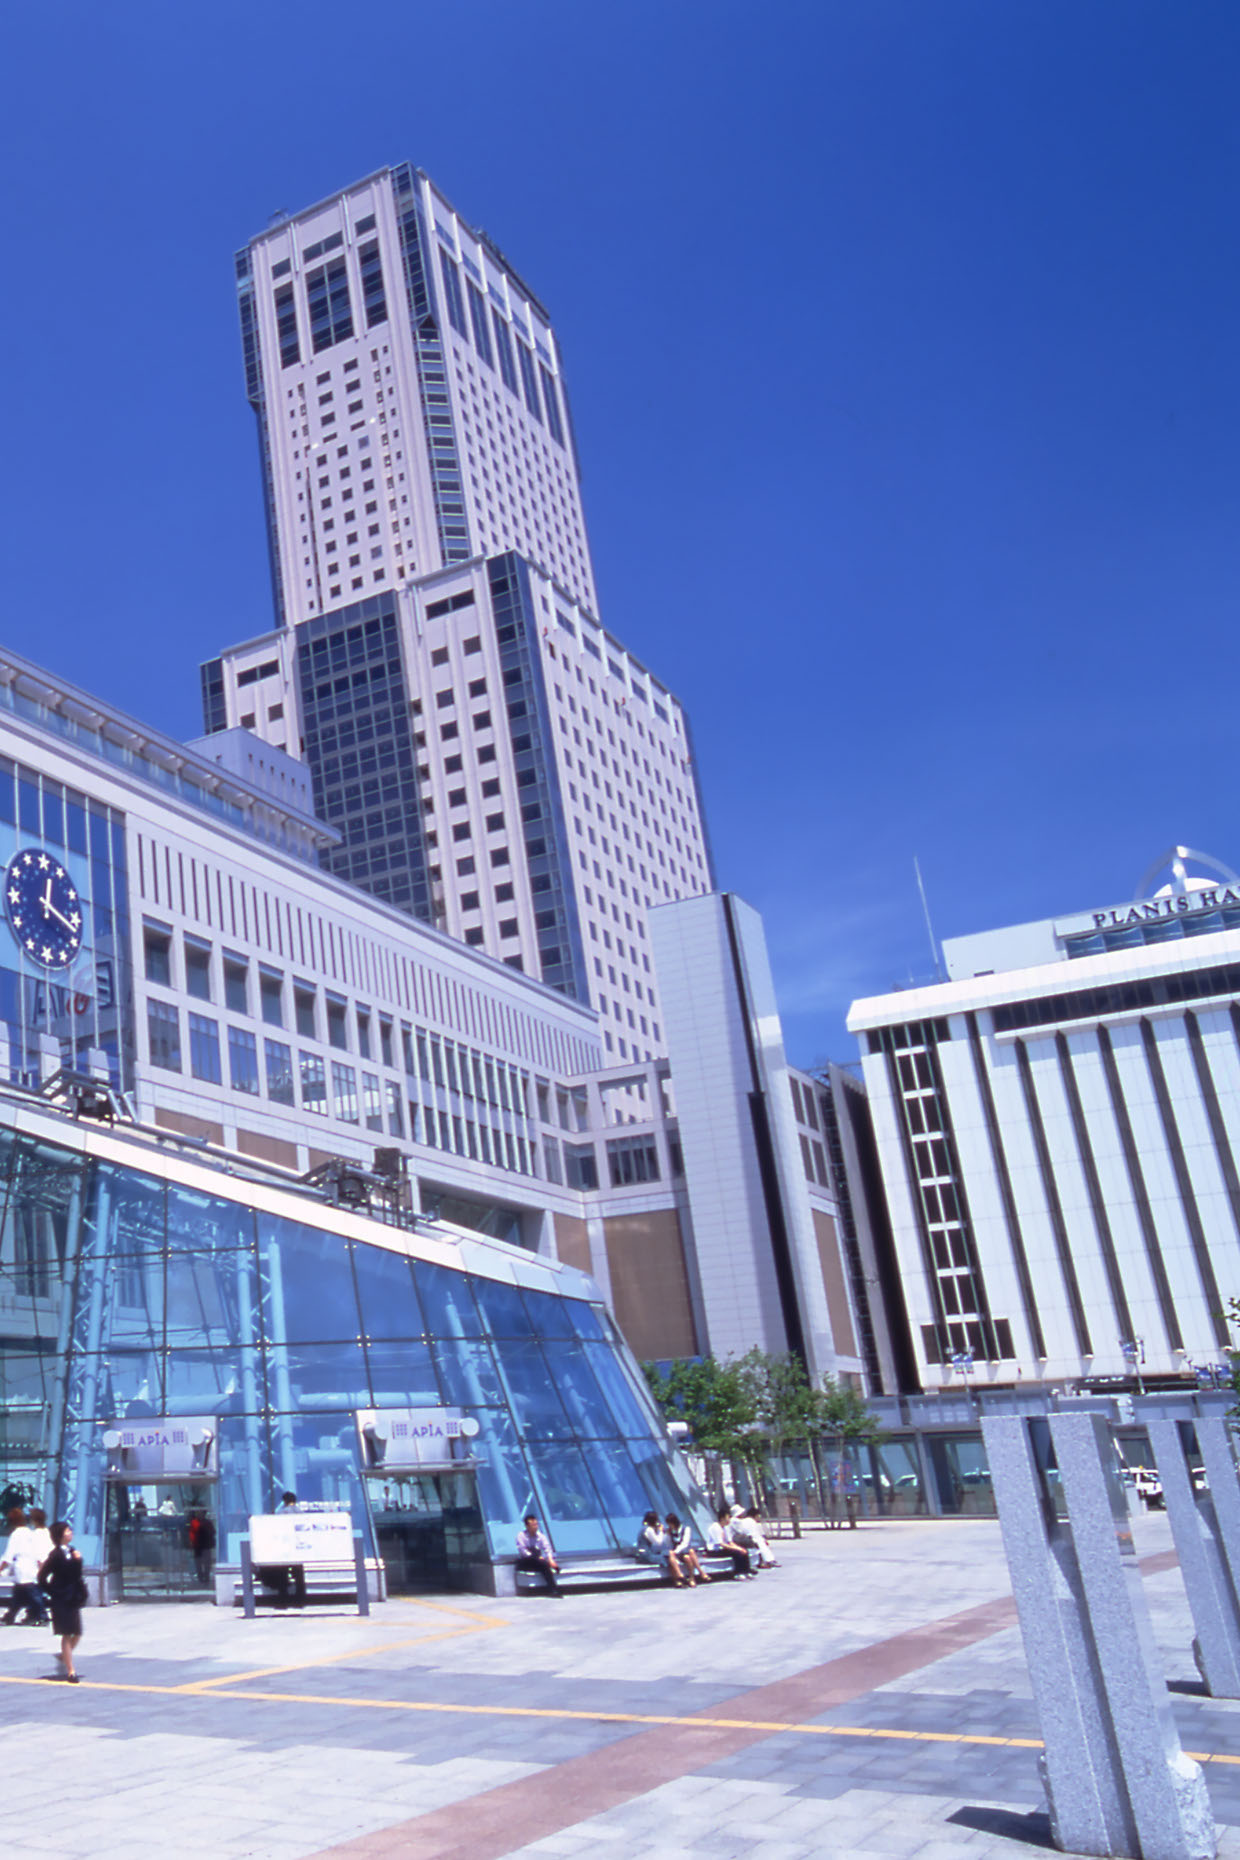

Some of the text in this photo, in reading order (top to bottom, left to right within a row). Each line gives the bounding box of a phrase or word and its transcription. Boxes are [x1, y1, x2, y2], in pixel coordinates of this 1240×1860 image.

[1092, 885, 1240, 928] PLANIS HA
[411, 1420, 443, 1438] APIA
[137, 1430, 170, 1447] APIA
